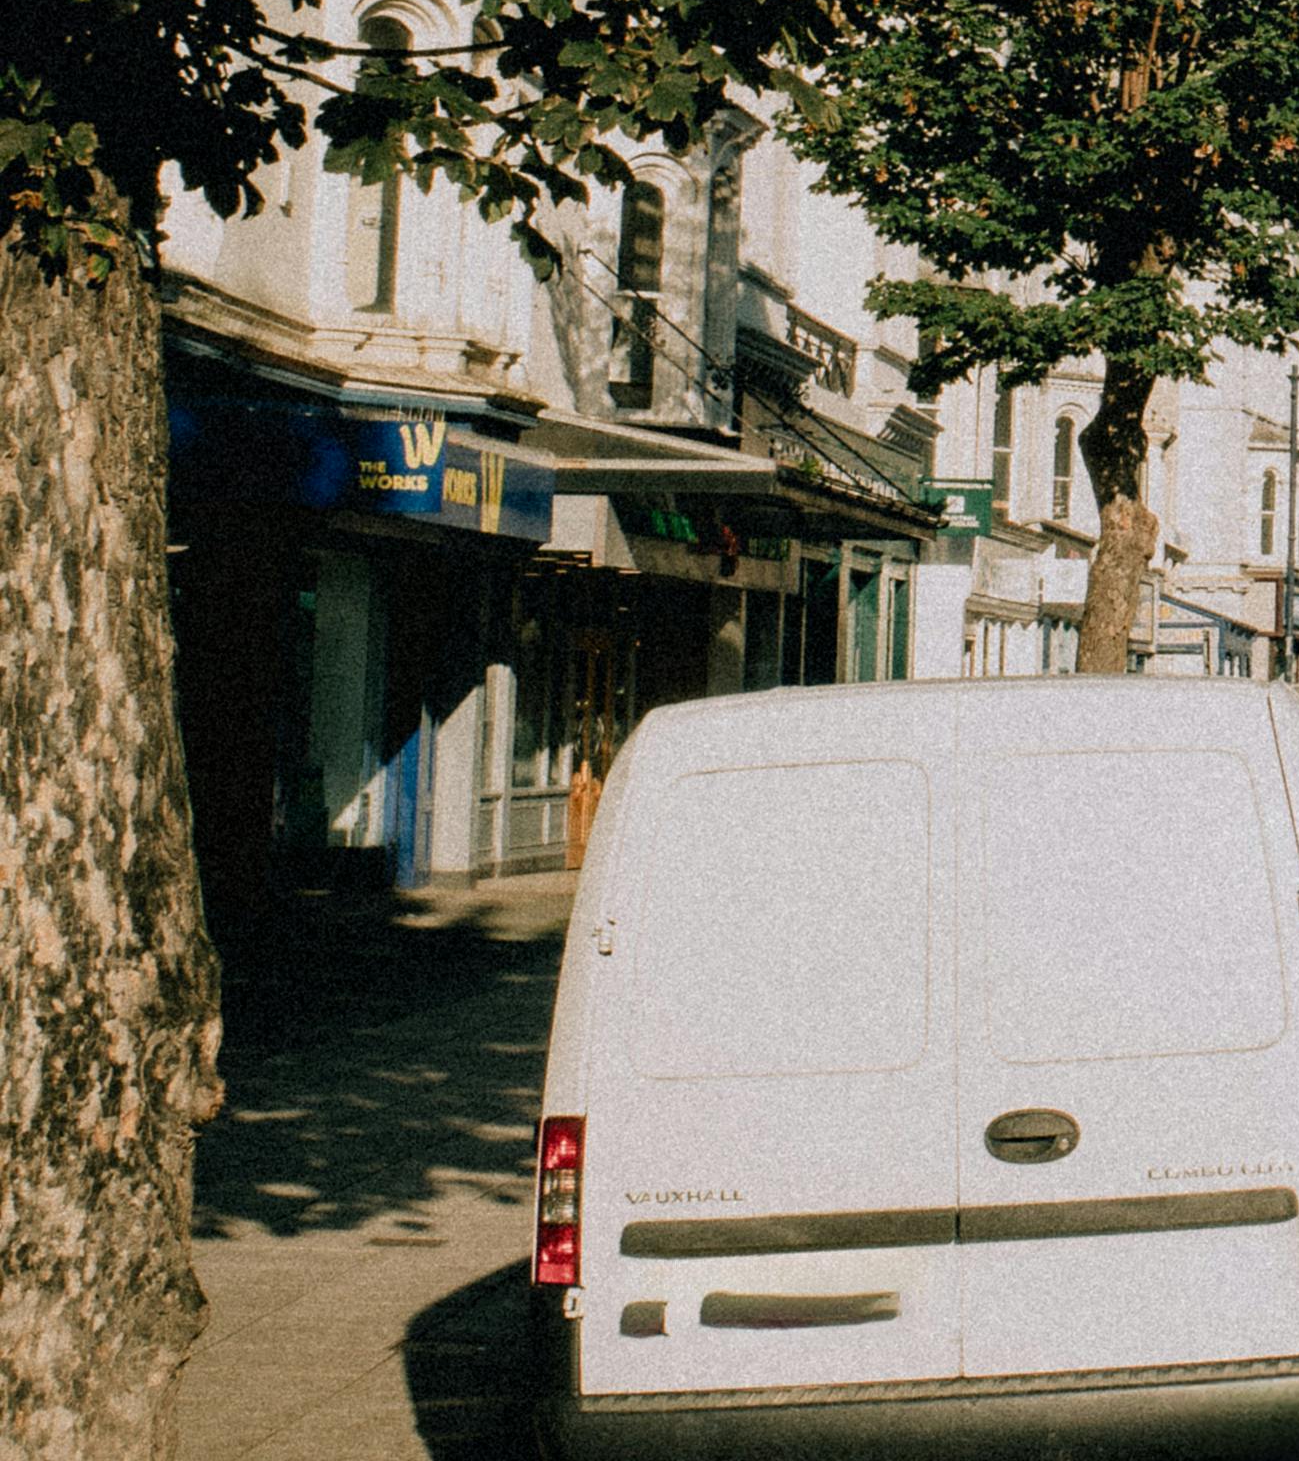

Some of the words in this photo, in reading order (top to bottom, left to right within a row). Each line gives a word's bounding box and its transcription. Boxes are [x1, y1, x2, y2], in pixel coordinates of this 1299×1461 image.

[358, 460, 387, 474] THE
[358, 474, 429, 492] WORKS
[625, 1189, 746, 1205] VAUXHALL
